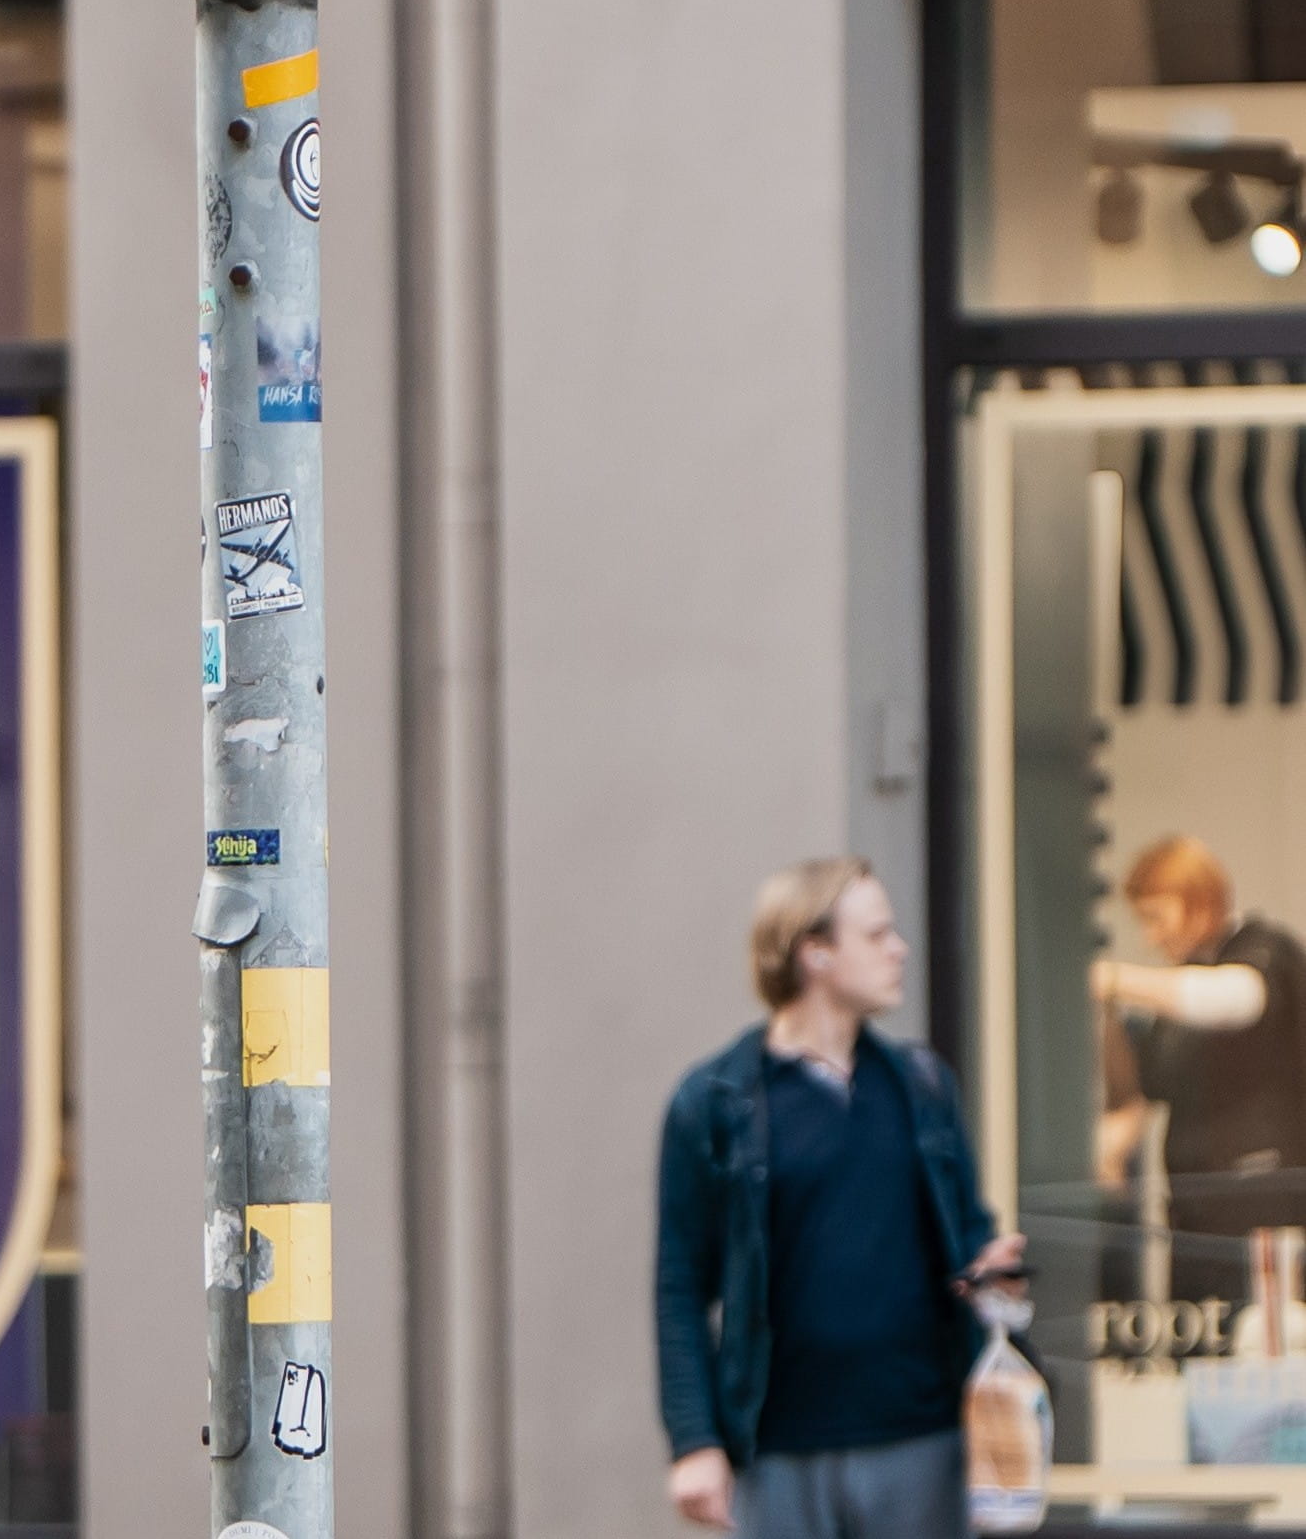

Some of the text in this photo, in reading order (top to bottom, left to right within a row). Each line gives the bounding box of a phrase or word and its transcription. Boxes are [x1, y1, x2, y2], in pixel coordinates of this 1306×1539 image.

[263, 385, 303, 406] HANSA
[218, 495, 290, 534] HERMANOS
[215, 835, 257, 857] Stihija
[1086, 1297, 1231, 1356] root
